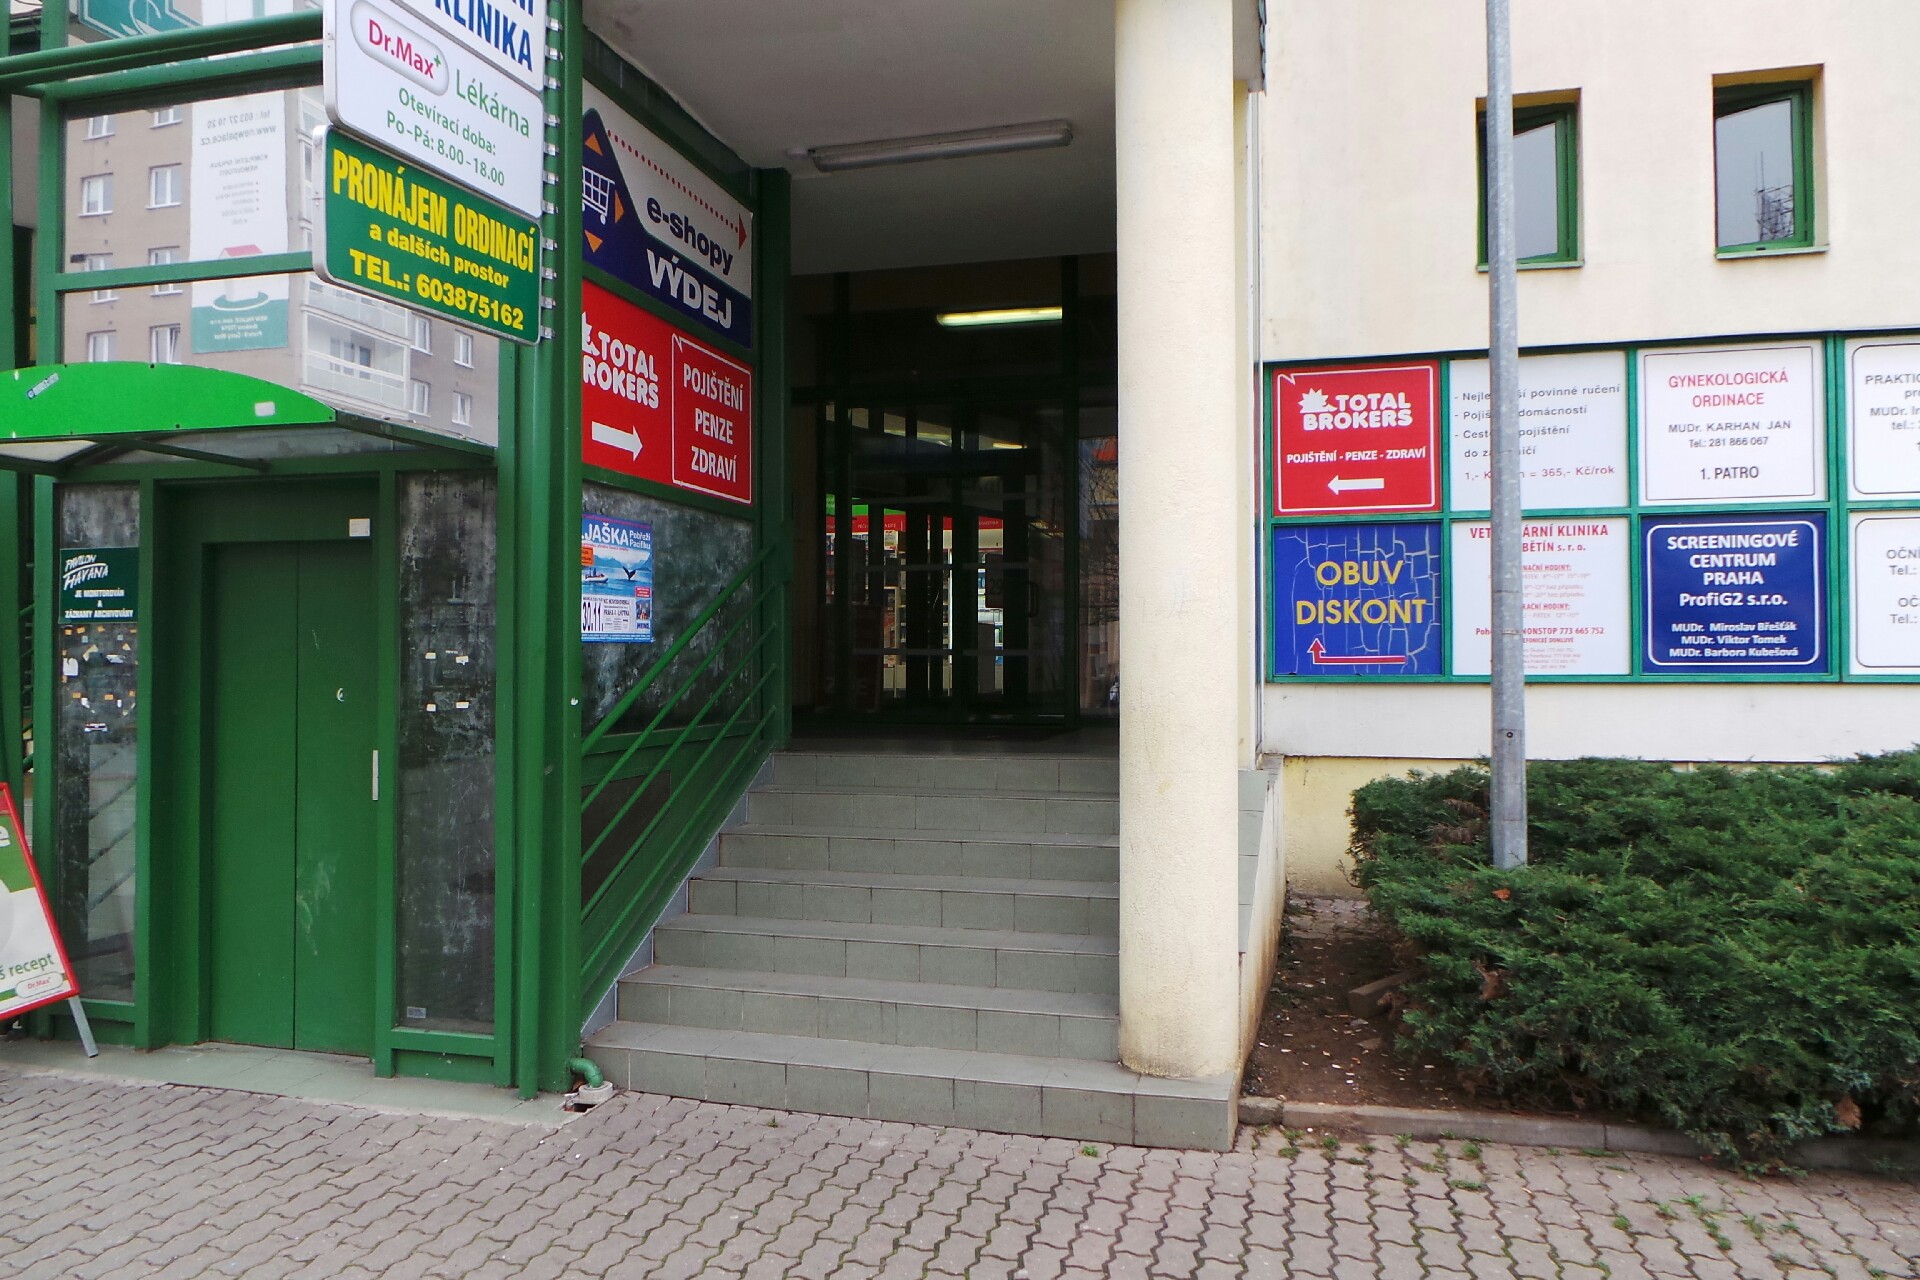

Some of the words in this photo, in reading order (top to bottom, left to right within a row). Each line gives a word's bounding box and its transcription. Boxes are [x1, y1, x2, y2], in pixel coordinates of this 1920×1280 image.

[369, 19, 434, 79] Dr.Max
[456, 68, 529, 138] Lékárna
[462, 124, 496, 156] doba:
[333, 148, 448, 238] PRONÁJEM
[454, 203, 535, 273] ORDINACÍ
[646, 197, 733, 275] e-shopy
[369, 223, 382, 241] a
[387, 228, 450, 266] dalších
[454, 255, 509, 288] prostor
[350, 248, 410, 292] TEL.:
[416, 274, 524, 330] 603875162
[647, 248, 732, 329] VÝDEJ
[598, 331, 659, 382] TOTAL
[583, 355, 659, 409] ROKERS
[1668, 367, 1788, 388] GYNEKOLOGICKÁ
[684, 363, 743, 412] POJIŠTĚNÍ
[1531, 387, 1578, 399] povinné
[1582, 383, 1621, 395] ručení
[1335, 392, 1411, 411] TOTAL
[1692, 393, 1765, 407] ORDINACE
[1303, 409, 1413, 431] BROKERS
[1870, 407, 1907, 416] MUDr.
[695, 408, 734, 445] PENZE
[1519, 425, 1570, 438] pojištění
[1668, 423, 1702, 433] MUDr.
[1706, 422, 1760, 431] KARHAN
[1767, 420, 1791, 430] JAN
[1709, 438, 1726, 447] 281
[1750, 436, 1769, 445] 067
[1287, 450, 1337, 463] POJIŠTĚNÍ
[1345, 450, 1377, 461] PENZE
[1386, 446, 1426, 459] ZDRAVÍ
[1464, 450, 1478, 458] do
[691, 445, 737, 483] ZDRAVÍ
[1575, 465, 1614, 476] Kč/rok
[1701, 468, 1711, 480] 1.
[1714, 466, 1759, 480] PATRO
[1557, 525, 1608, 537] KLINIKA
[1667, 530, 1798, 549] SCREENINGOVÉ
[1690, 553, 1776, 568] CENTRUM
[64, 565, 109, 590] HAVANA
[1316, 560, 1404, 585] OBUV
[1703, 571, 1764, 585] PRAHA
[1679, 592, 1743, 606] ProfiG2
[1747, 594, 1788, 606] s.r.o.
[1296, 599, 1426, 624] DISKONT
[1560, 627, 1573, 635] 773
[1575, 627, 1589, 635] 665
[1671, 623, 1705, 632] MUDr.
[1710, 622, 1755, 631] Miroslav
[1681, 635, 1715, 644] MUDr.
[1717, 634, 1750, 644] Viktor
[1752, 634, 1787, 643] Tomek
[1669, 648, 1703, 657] MUDr.
[1704, 648, 1746, 657] Barbora
[1748, 647, 1799, 656] Kubešová
[9, 952, 54, 977] recept
